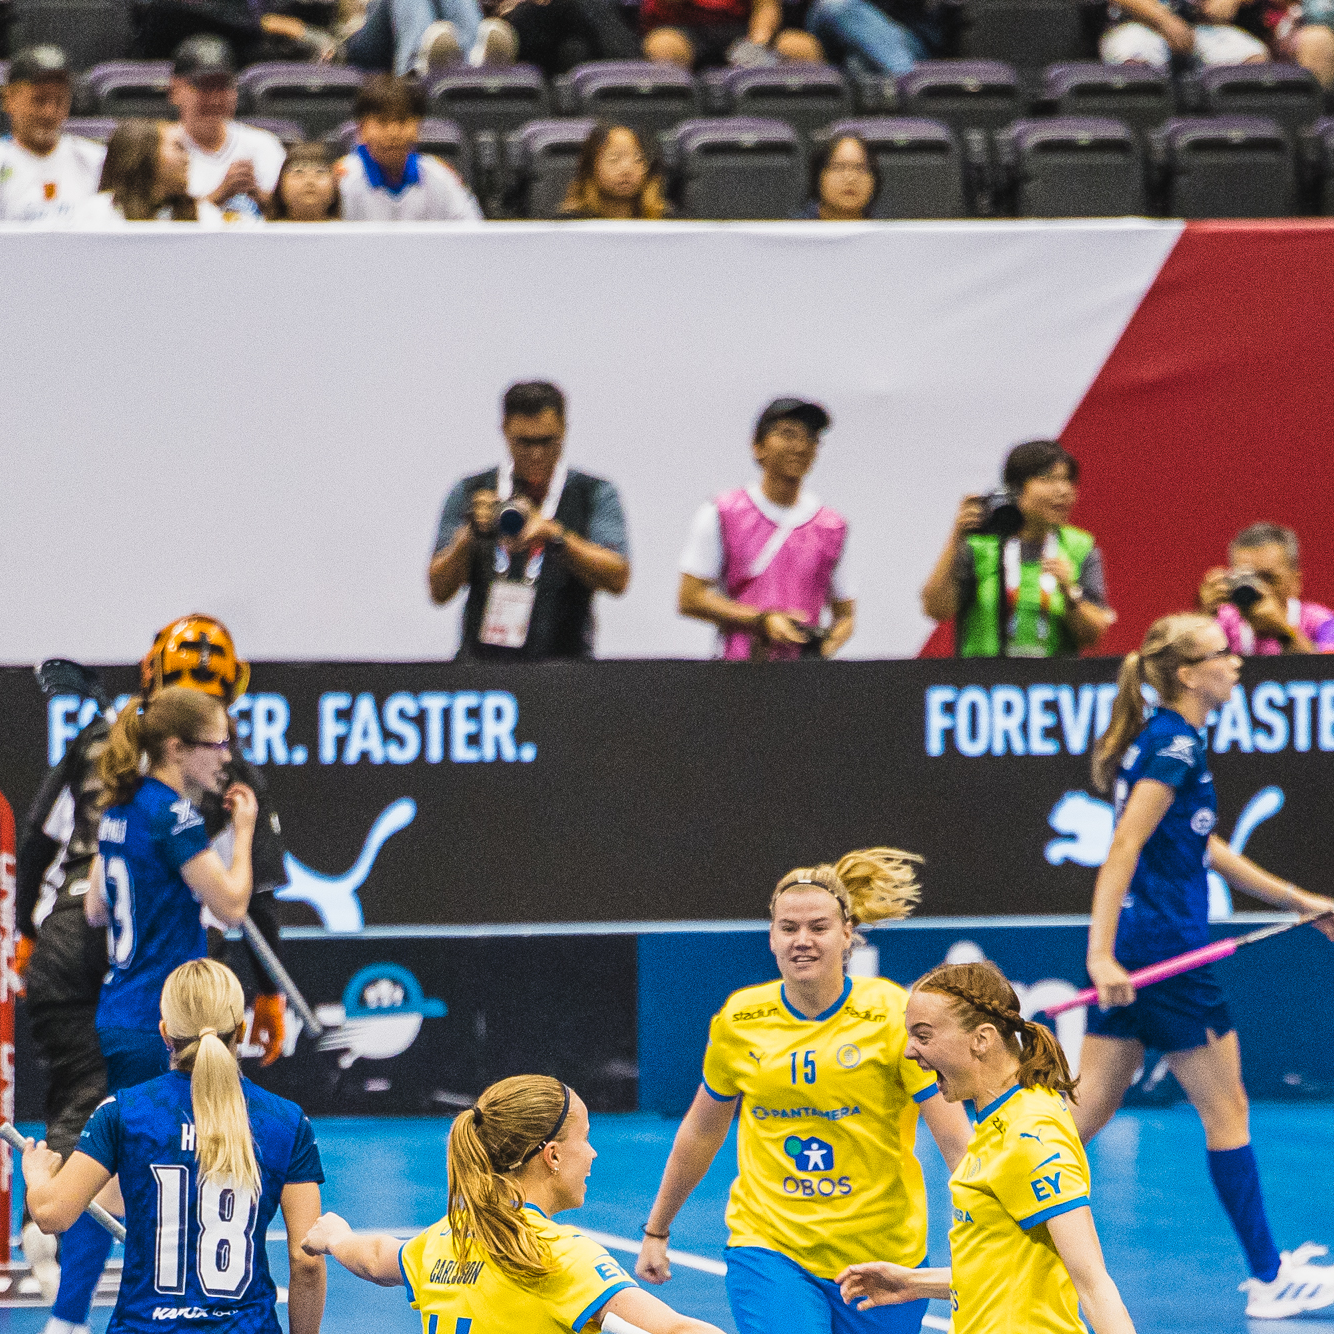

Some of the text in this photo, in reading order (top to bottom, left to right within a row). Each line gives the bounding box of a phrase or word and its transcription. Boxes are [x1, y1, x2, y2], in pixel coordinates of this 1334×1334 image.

[318, 690, 537, 765] FASTER.
[732, 1006, 886, 1023] stadium stadium
[790, 1049, 817, 1085] 15
[772, 1105, 861, 1121] PANTAMERA
[783, 1176, 853, 1197] OBOS
[1030, 1171, 1061, 1202] EY
[150, 1164, 260, 1300] 18
